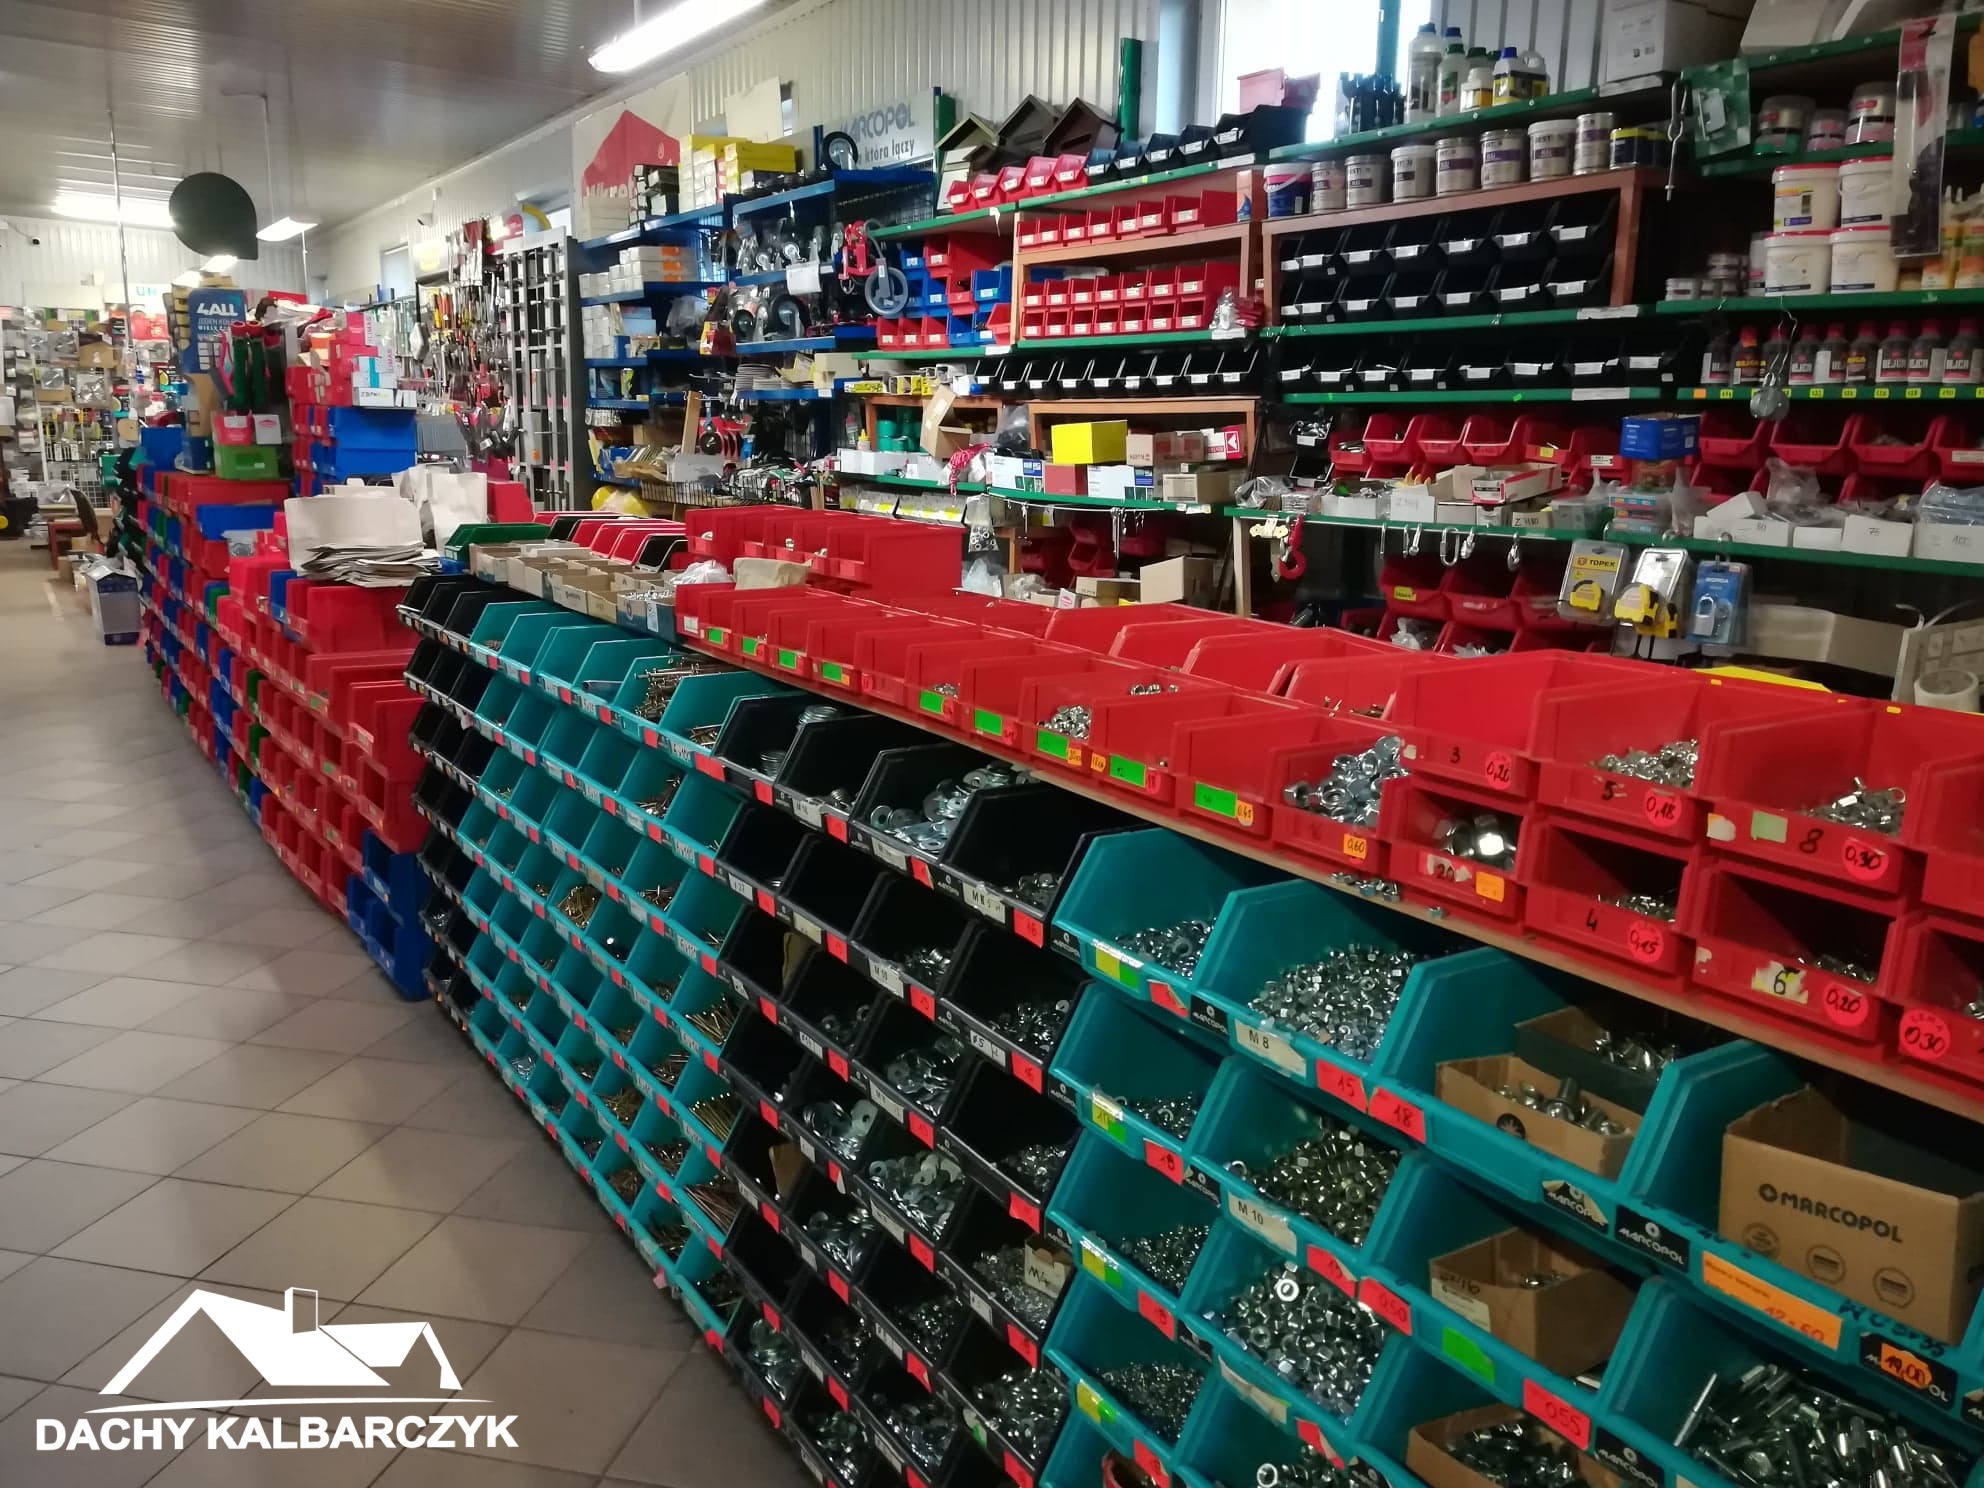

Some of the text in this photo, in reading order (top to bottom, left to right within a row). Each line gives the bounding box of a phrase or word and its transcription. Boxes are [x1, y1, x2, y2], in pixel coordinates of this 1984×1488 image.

[1589, 560, 1615, 568] TOPEX
[1451, 746, 1461, 764] 3
[1601, 781, 1614, 800] 5
[1800, 829, 1823, 854] 8
[1773, 970, 1787, 995] 6
[1249, 1030, 1270, 1049] M 8
[1238, 1201, 1264, 1225] M 10
[1781, 1191, 1903, 1244] MARCOPOL
[1619, 1228, 1684, 1265] MARCOPOL
